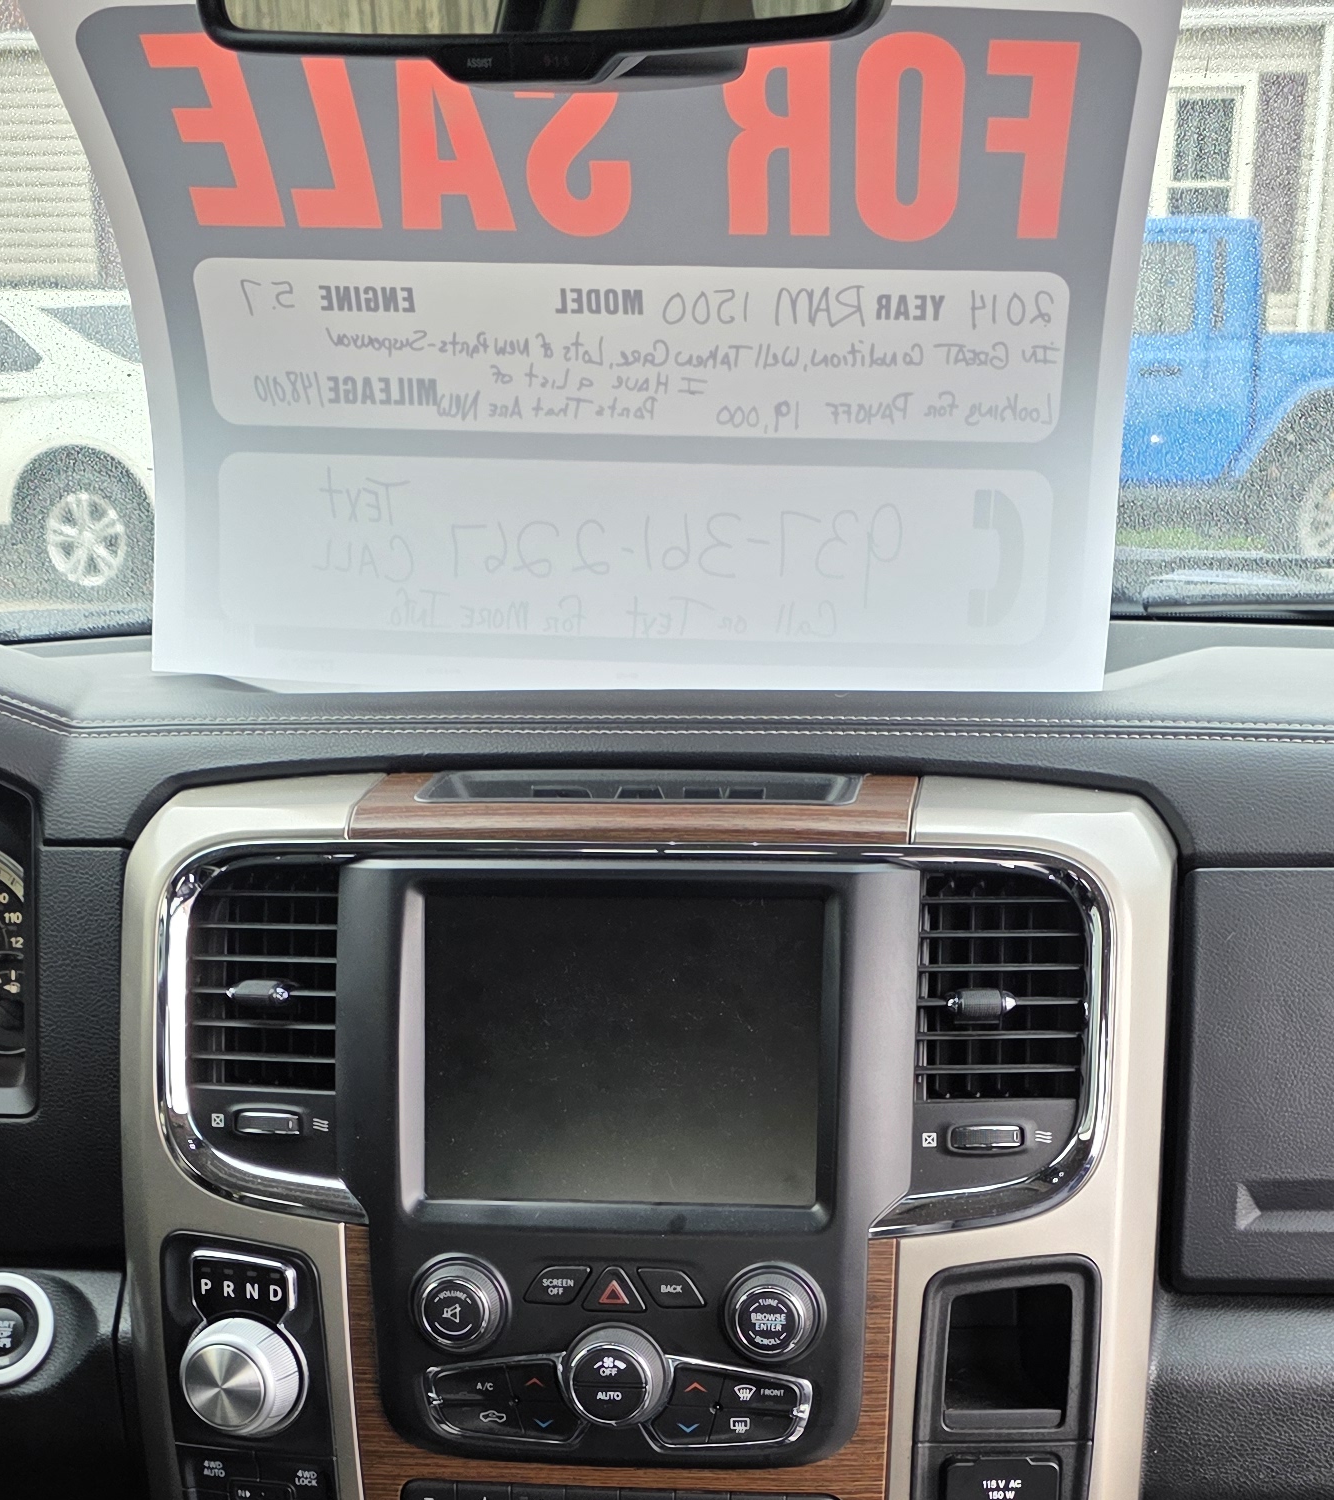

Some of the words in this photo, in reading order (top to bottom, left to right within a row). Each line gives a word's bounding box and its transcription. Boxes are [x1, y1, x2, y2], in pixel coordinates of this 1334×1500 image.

[4, 911, 23, 924] 110
[542, 1278, 575, 1288] SCREEN
[200, 1278, 212, 1295] P
[223, 1280, 236, 1298] R
[246, 1282, 259, 1300] N
[269, 1284, 283, 1302] D
[547, 1287, 564, 1296] OFF
[660, 1284, 683, 1293] BACK
[437, 1290, 468, 1301] VOLUME
[758, 1298, 779, 1307] TUNE
[750, 1312, 786, 1321] BROWSE
[754, 1322, 783, 1332] ENTER
[754, 1336, 782, 1346] SCROLL
[599, 1367, 618, 1377] OFF
[475, 1381, 494, 1391] A/C
[596, 1391, 623, 1401] AUTO
[760, 1388, 785, 1397] FRONT
[203, 1460, 224, 1470] 4WD
[203, 1468, 226, 1478] AUTO
[296, 1469, 318, 1479] 4WD
[295, 1478, 318, 1487] LOCK
[1008, 1479, 1023, 1489] AC
[1005, 1490, 1016, 1500] W
